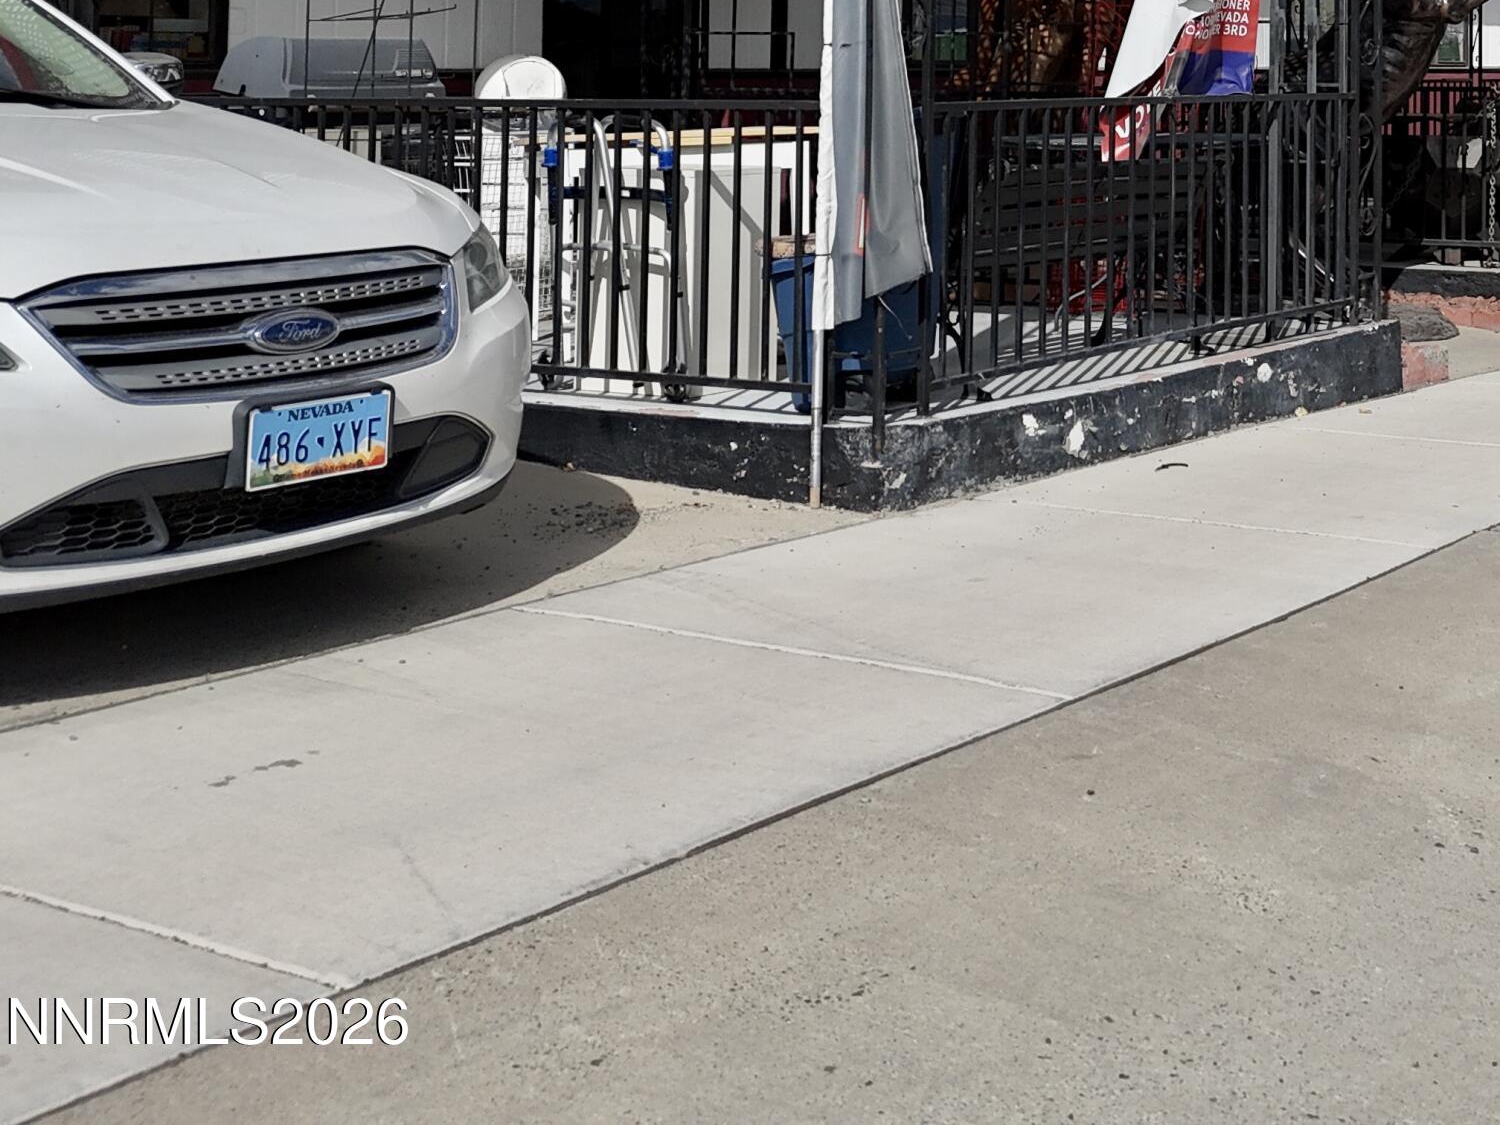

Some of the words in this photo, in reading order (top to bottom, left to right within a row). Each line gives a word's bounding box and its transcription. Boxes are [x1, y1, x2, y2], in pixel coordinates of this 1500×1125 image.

[1223, 24, 1248, 36] 3RD
[279, 320, 322, 341] Ford
[287, 400, 354, 422] NEVADA
[257, 429, 310, 472] 486
[331, 417, 382, 458] XYF
